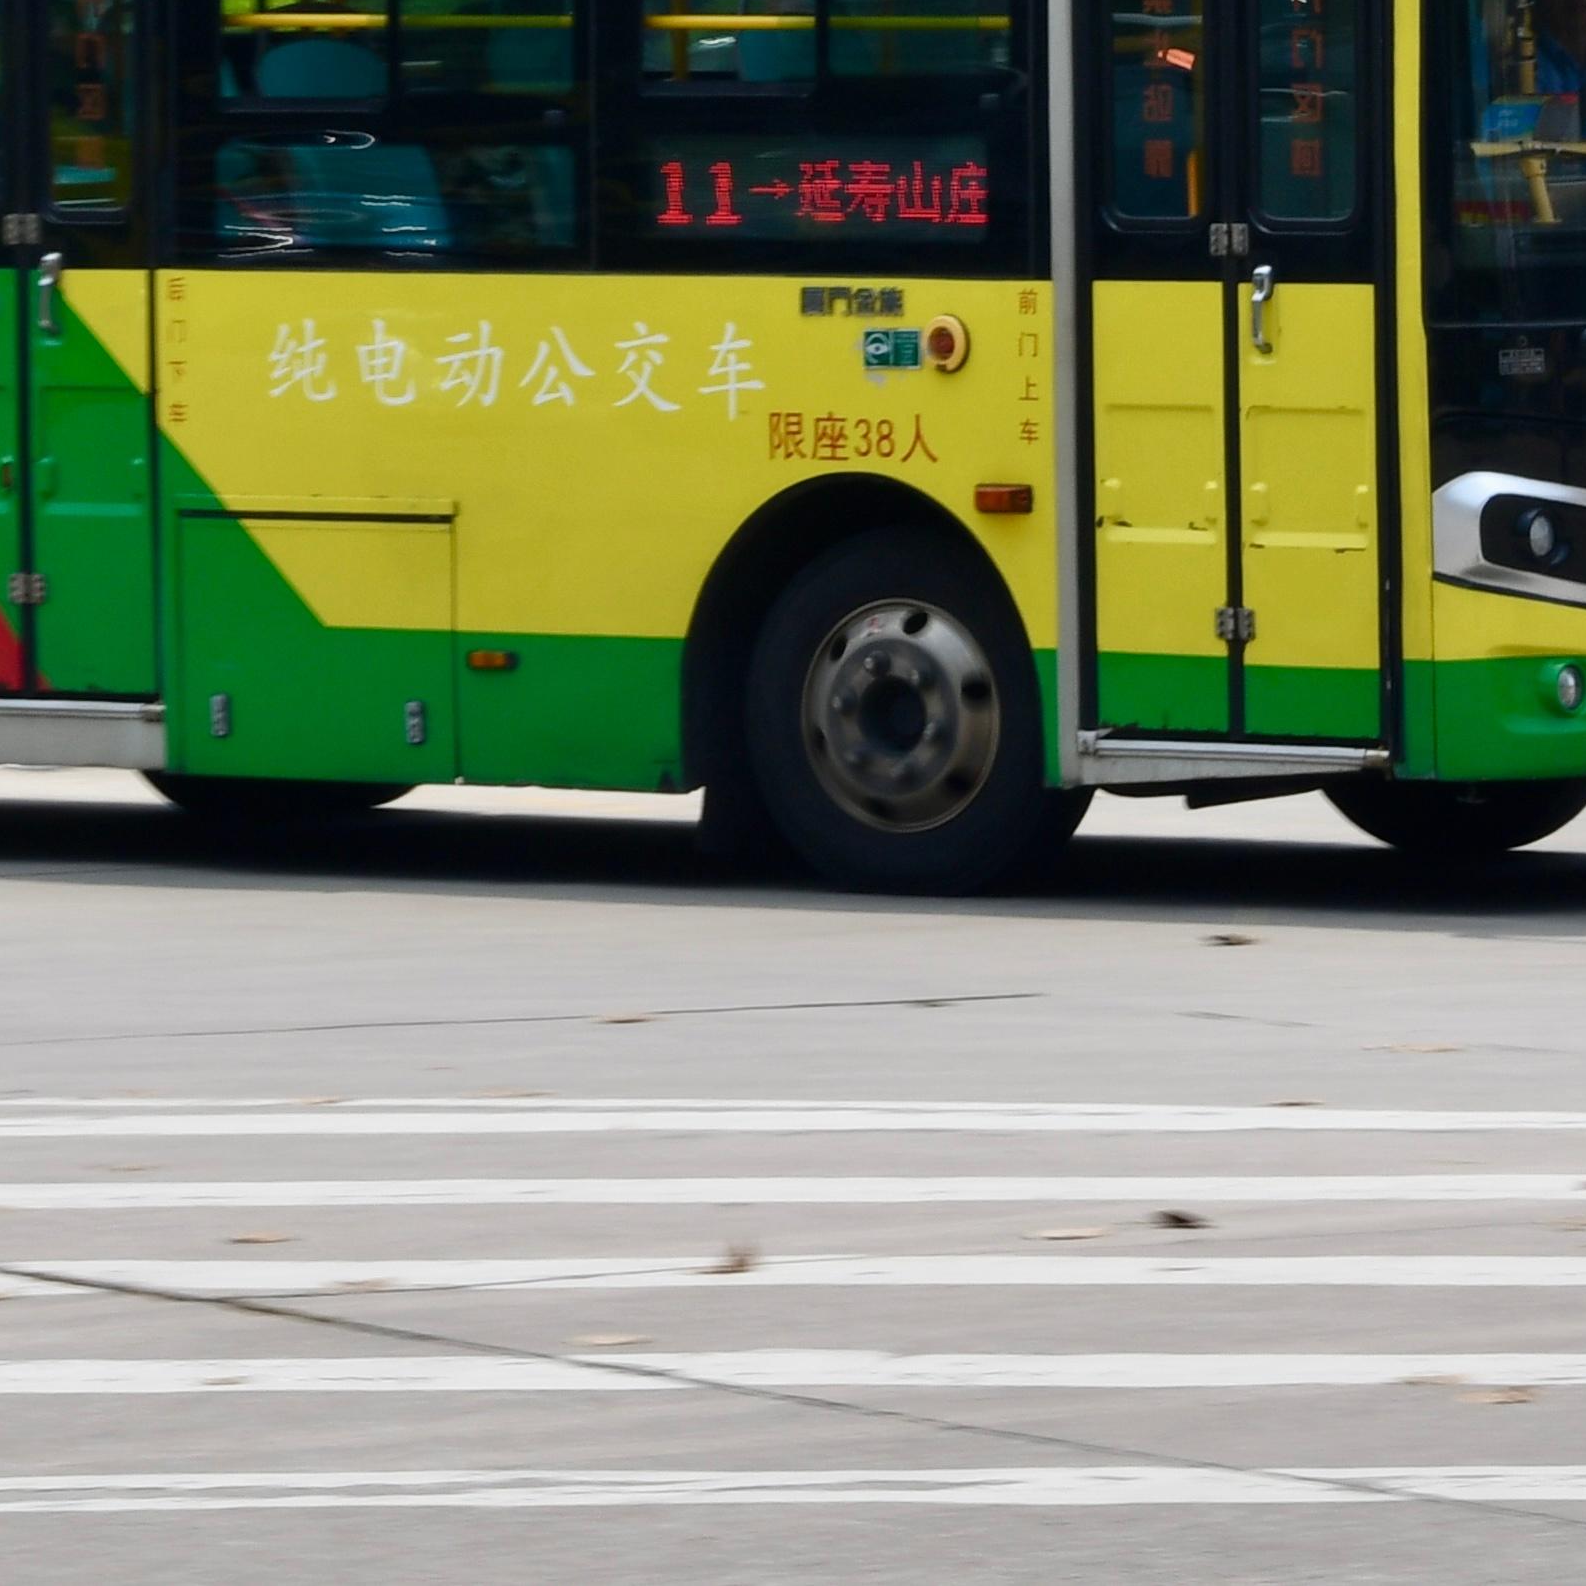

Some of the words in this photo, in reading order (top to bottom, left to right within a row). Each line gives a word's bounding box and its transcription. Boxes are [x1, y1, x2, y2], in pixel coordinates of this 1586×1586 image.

[657, 161, 743, 225] 11
[793, 160, 990, 225] 延寿山庄
[267, 318, 767, 421] 纯电动公交车
[1017, 288, 1040, 446] 前门上车
[768, 411, 939, 464] 限座38人
